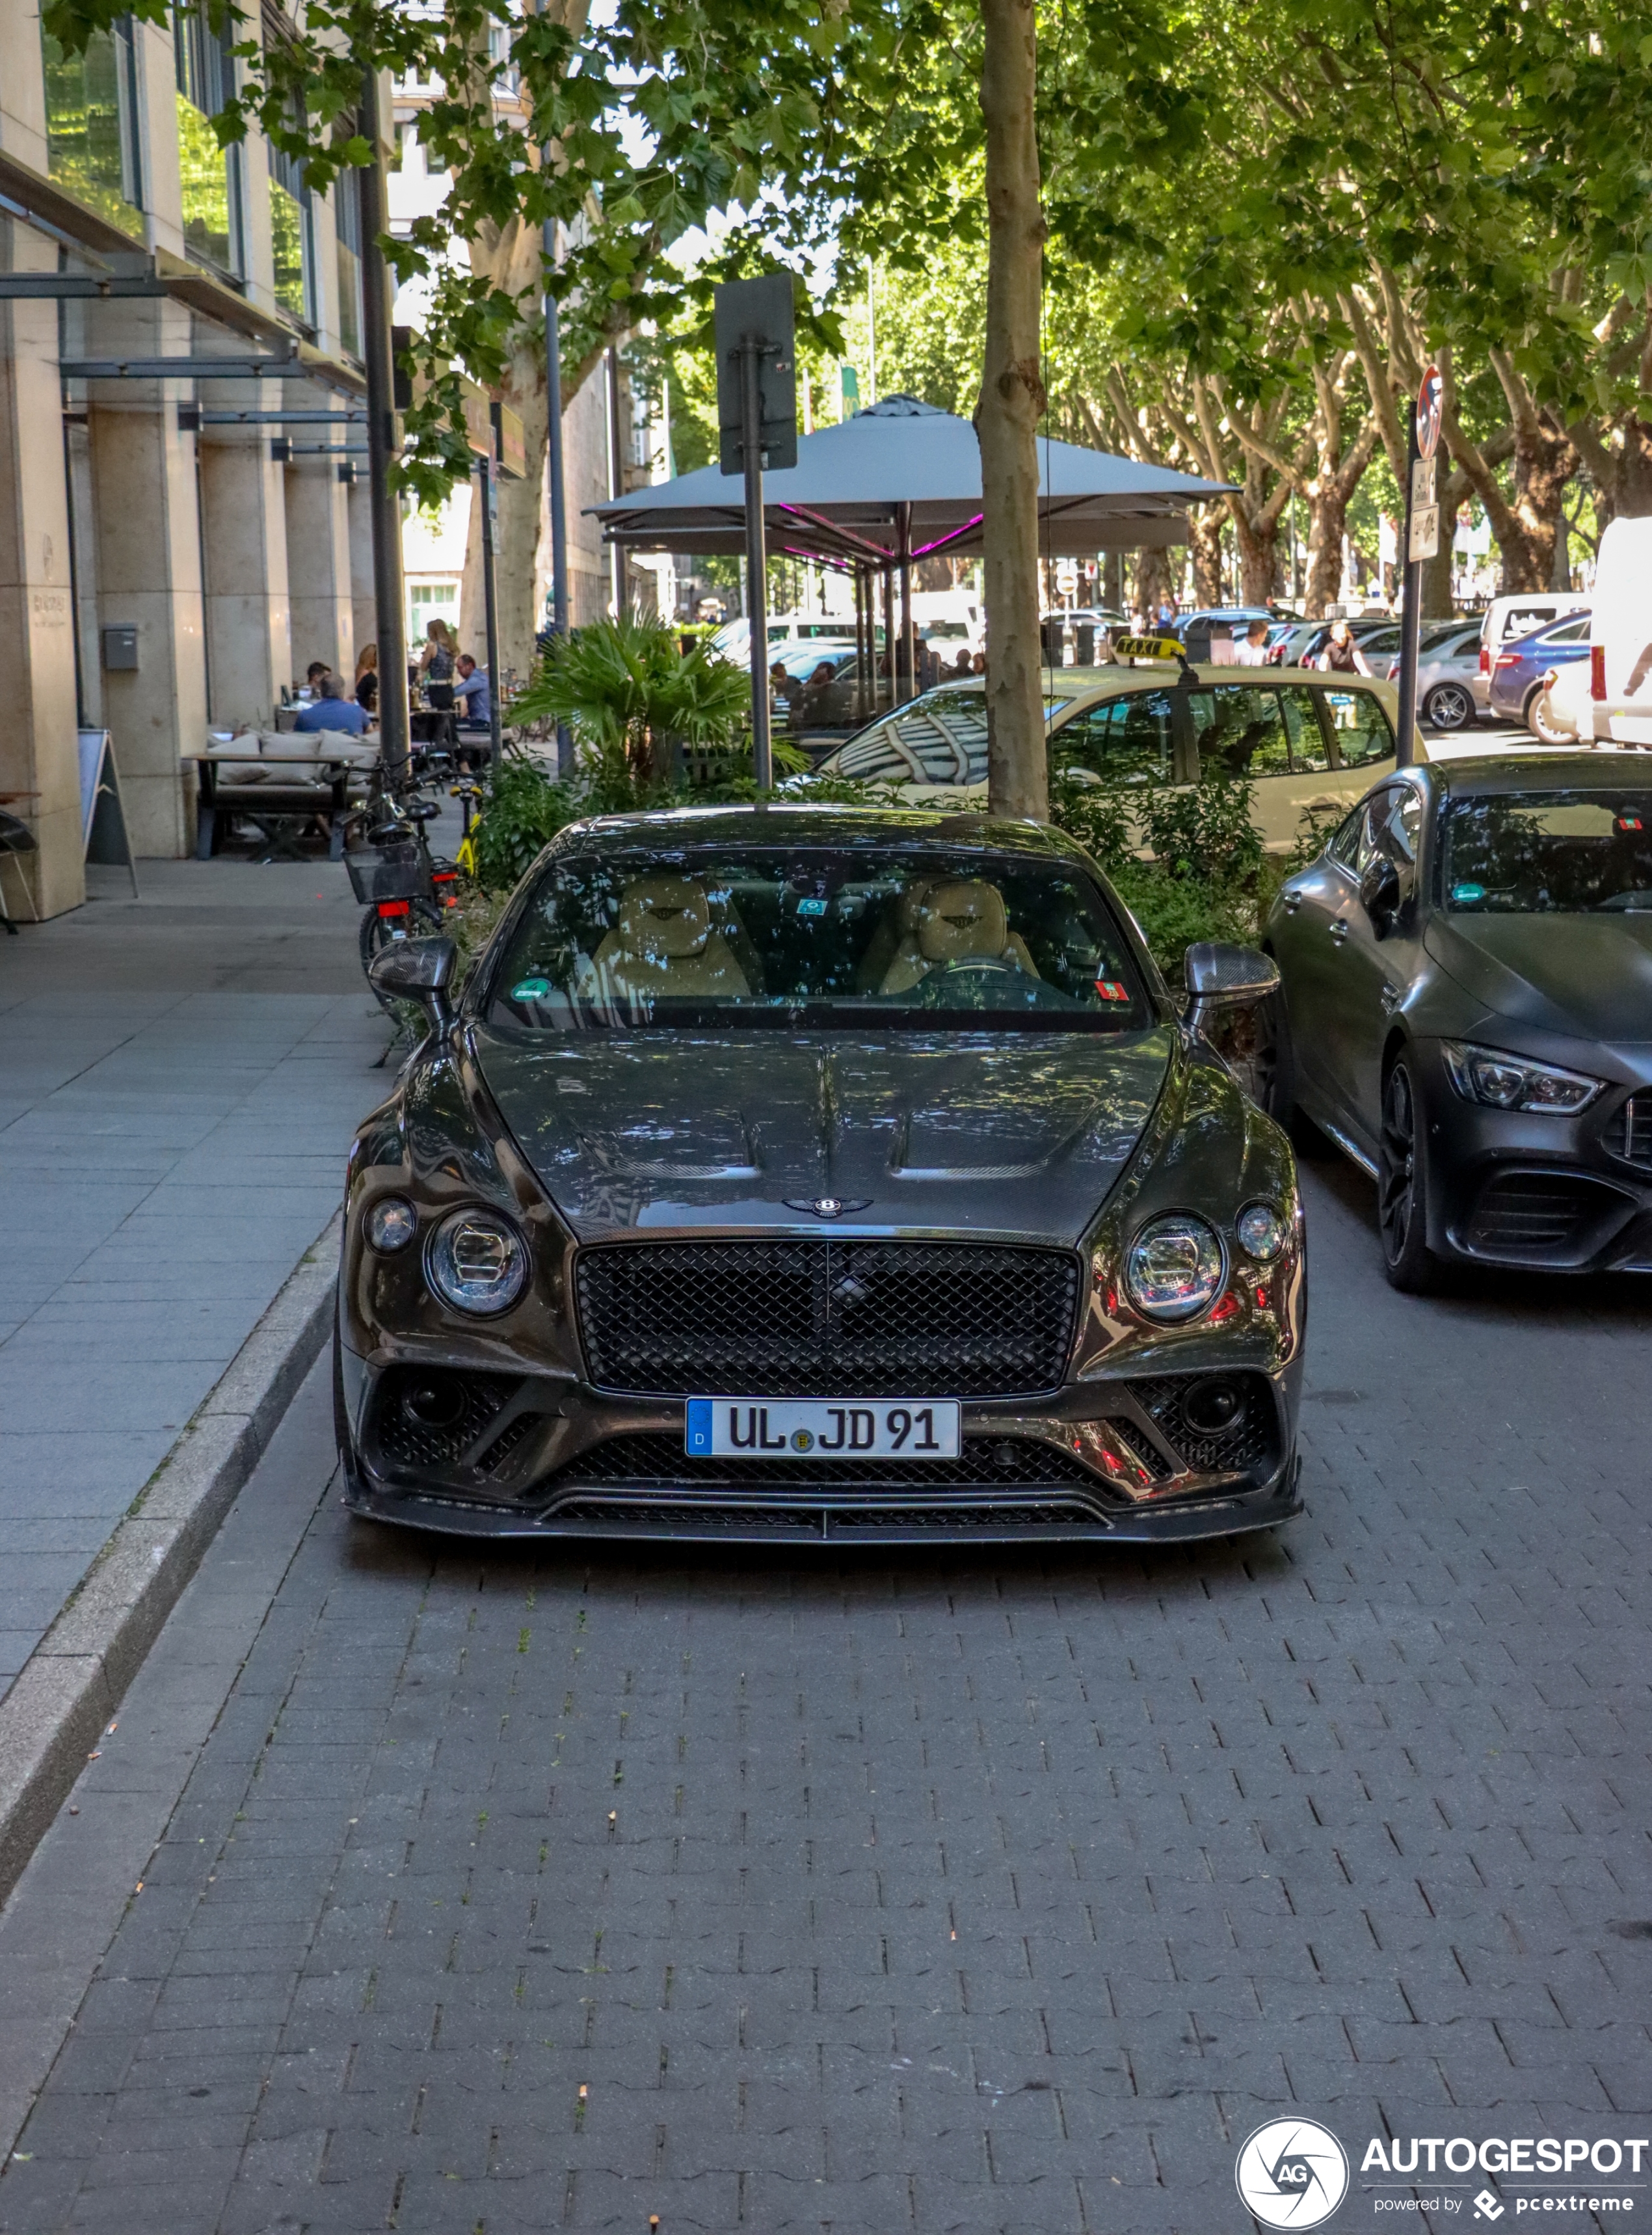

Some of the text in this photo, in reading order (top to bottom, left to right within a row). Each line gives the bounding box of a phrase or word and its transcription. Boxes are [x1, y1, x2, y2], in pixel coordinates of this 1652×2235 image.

[1123, 639, 1156, 654] TAXI
[528, 981, 539, 991] 4
[820, 1199, 835, 1209] B
[730, 1406, 786, 1449] UL
[818, 1407, 875, 1449] JD
[886, 1408, 940, 1450] 91
[694, 1433, 705, 1445] D
